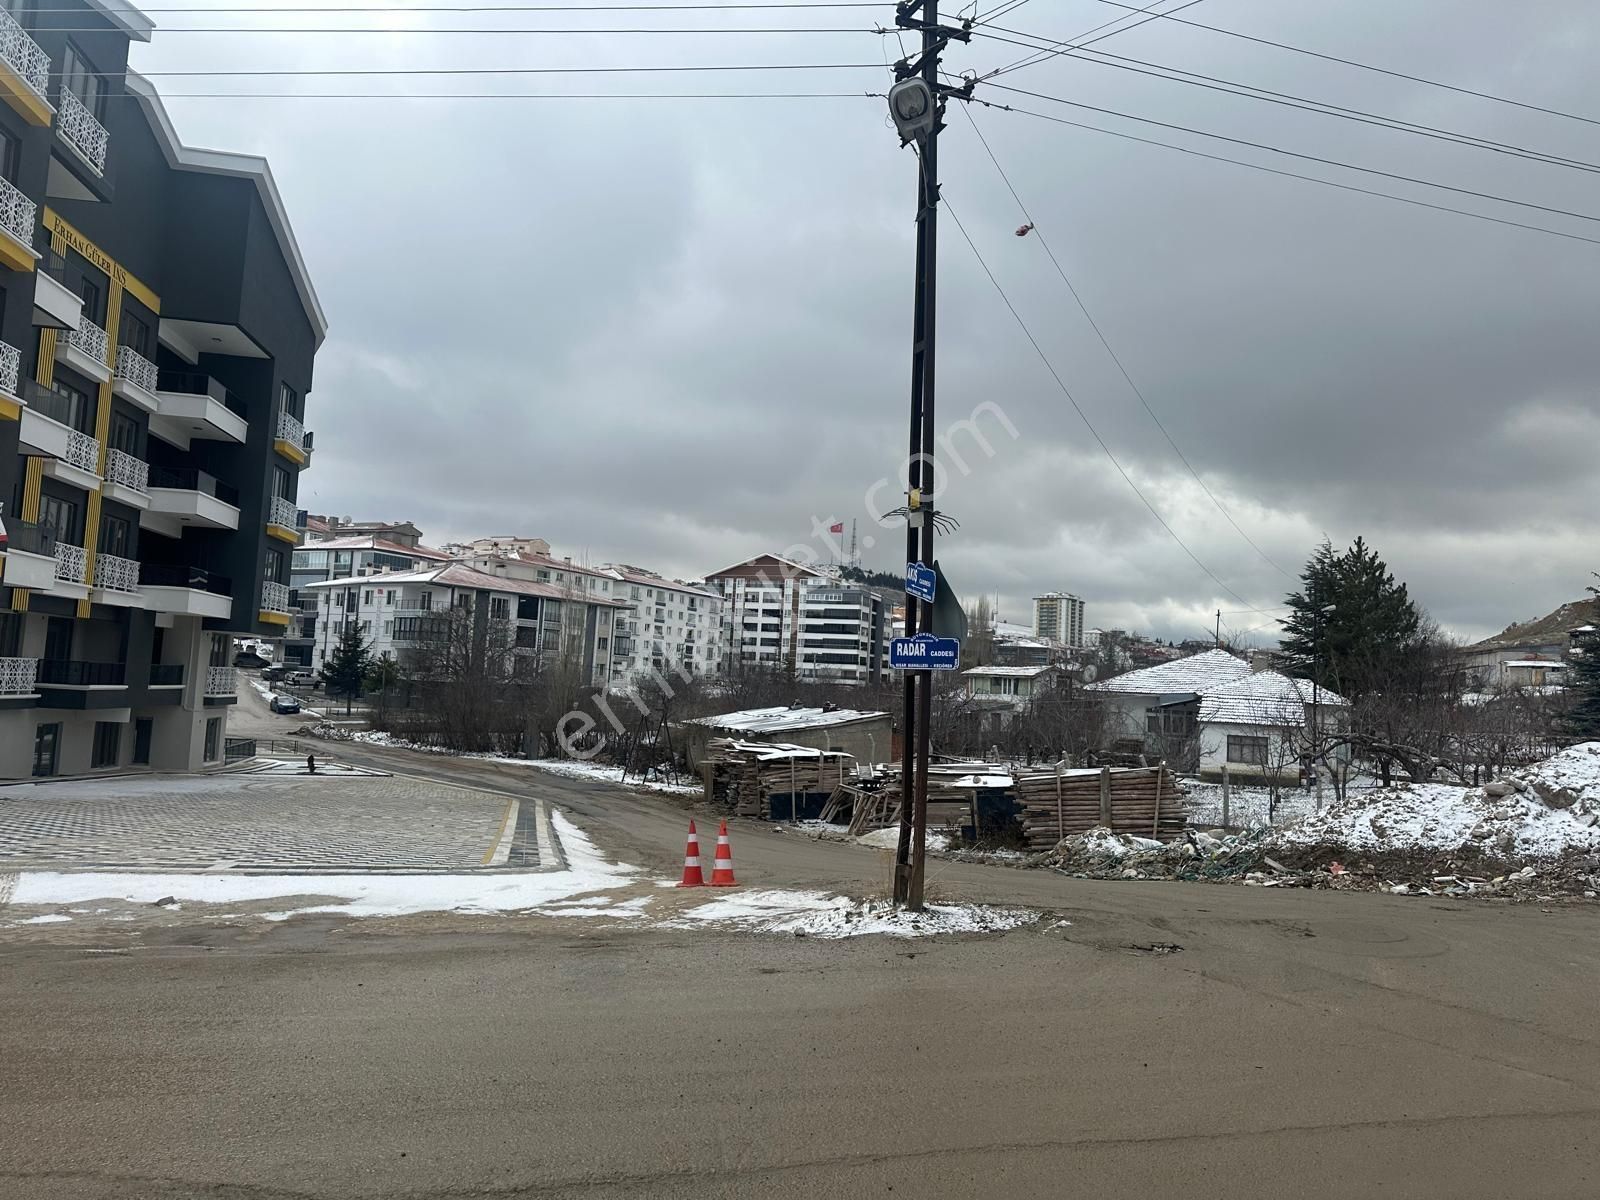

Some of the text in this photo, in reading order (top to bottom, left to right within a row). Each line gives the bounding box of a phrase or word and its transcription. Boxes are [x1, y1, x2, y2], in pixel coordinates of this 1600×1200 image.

[54, 215, 84, 253] ERHAN
[85, 242, 111, 274] GÜLER
[896, 642, 926, 657] RADAR
